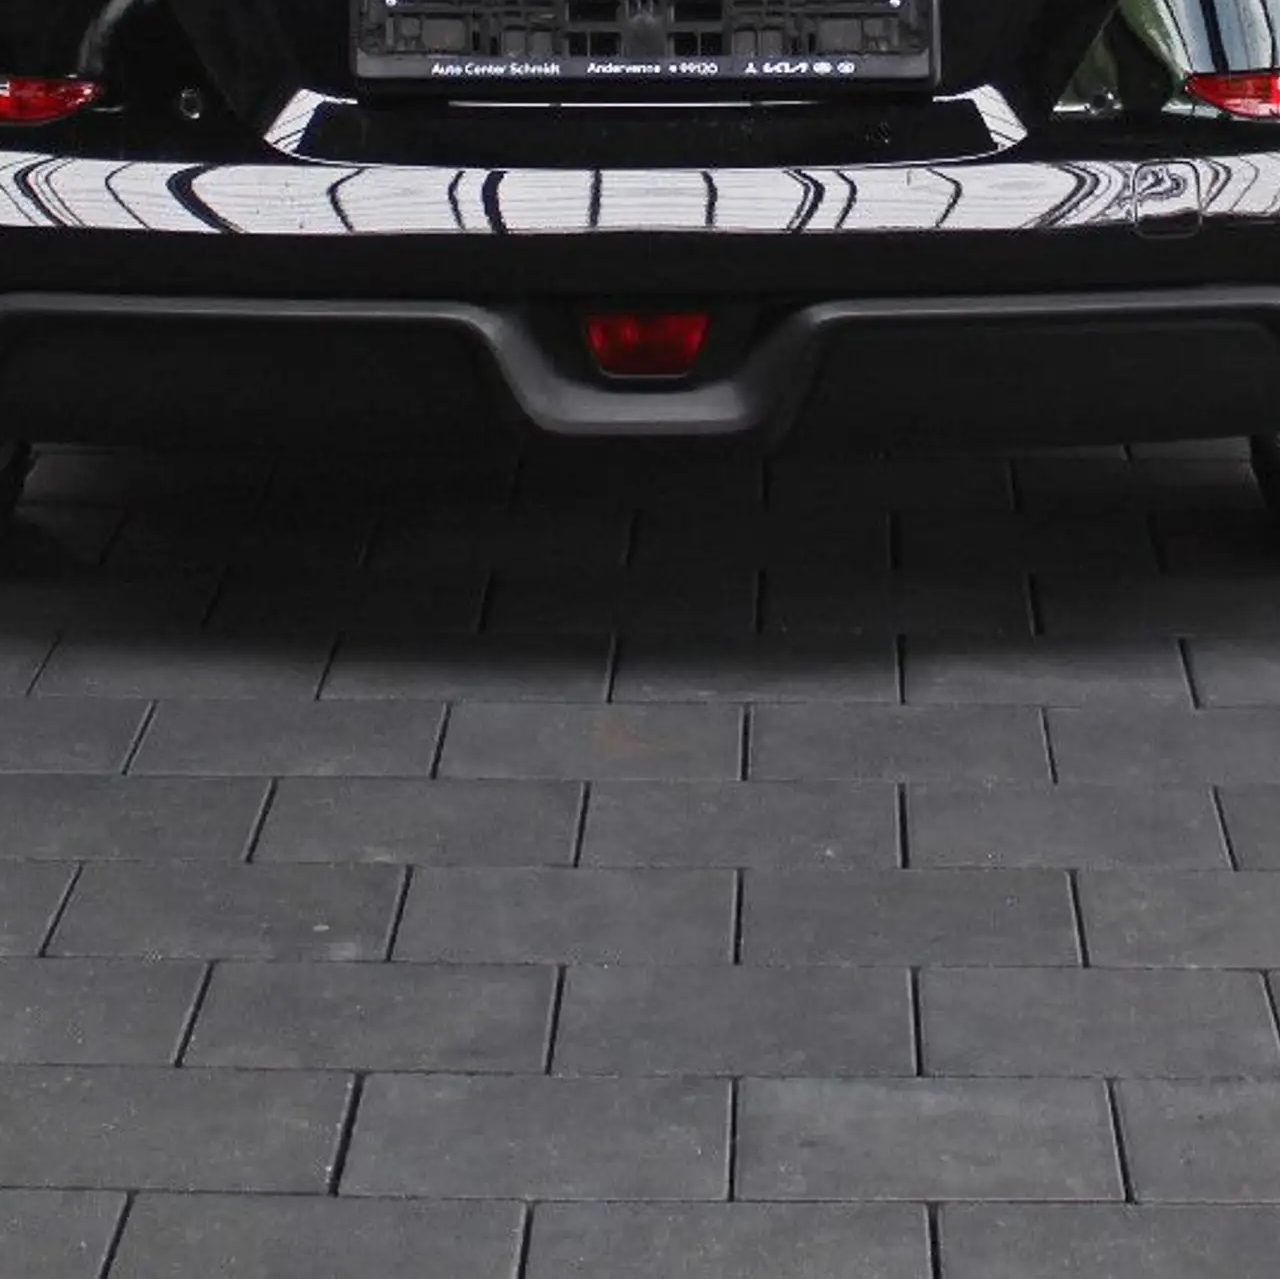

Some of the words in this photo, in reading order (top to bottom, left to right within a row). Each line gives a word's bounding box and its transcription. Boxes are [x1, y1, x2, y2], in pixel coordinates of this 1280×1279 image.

[431, 62, 462, 76] Auto
[465, 62, 506, 75] Center
[510, 62, 560, 76] Schmidt
